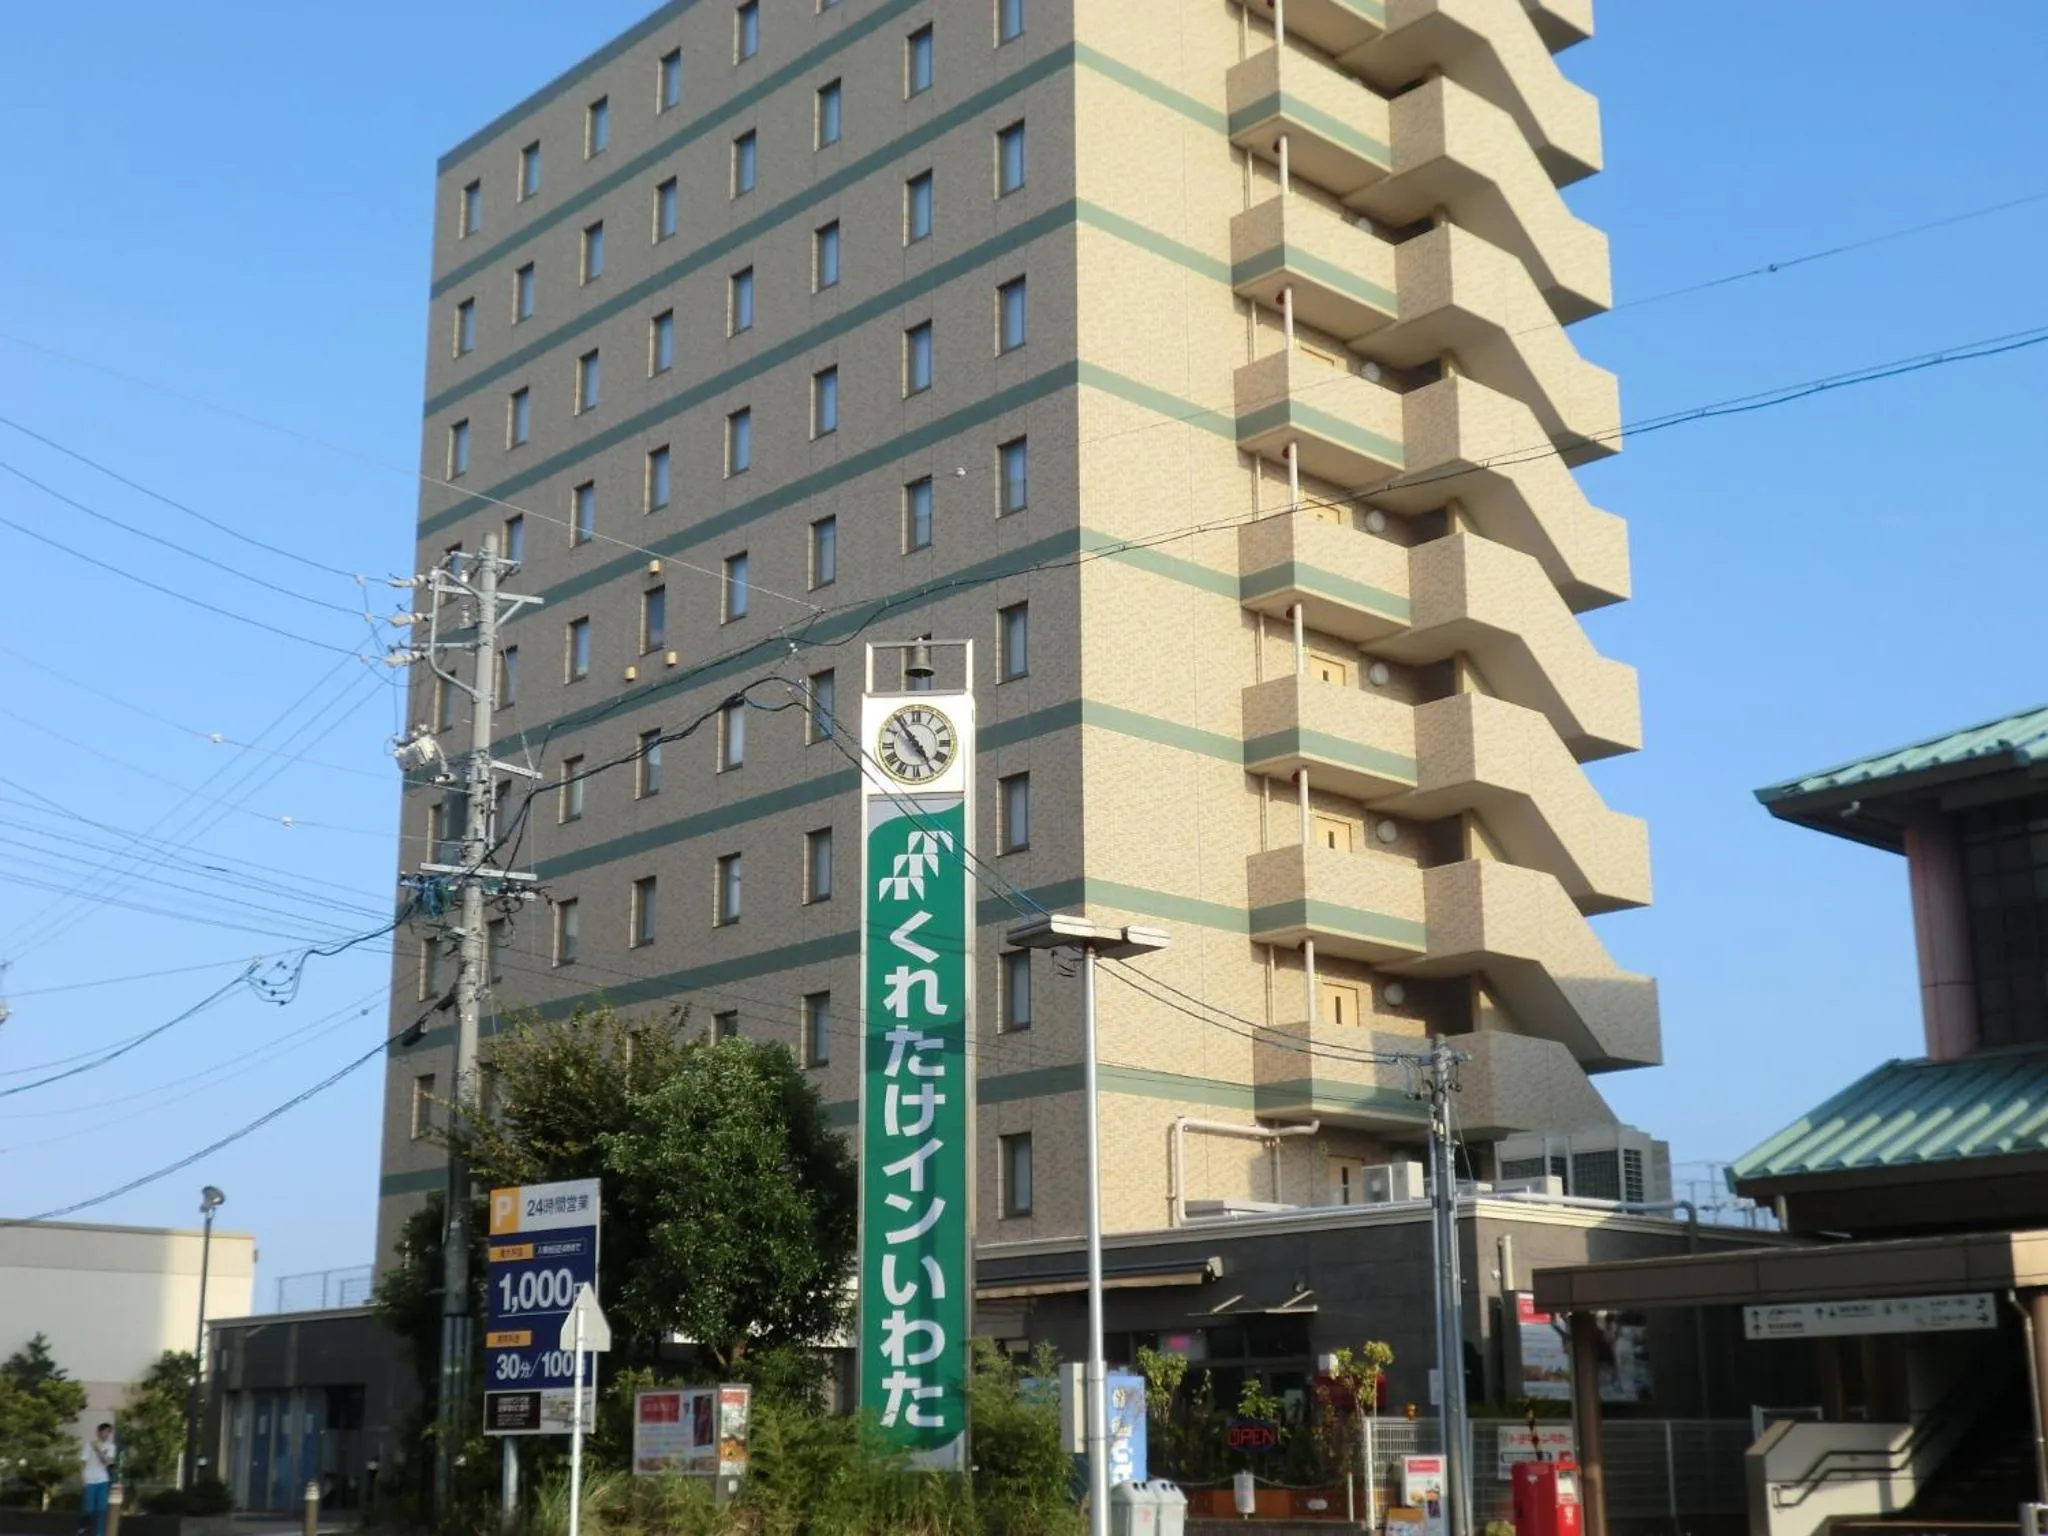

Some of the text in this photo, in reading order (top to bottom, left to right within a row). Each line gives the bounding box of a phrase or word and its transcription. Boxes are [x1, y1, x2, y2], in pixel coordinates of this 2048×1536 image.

[880, 910, 948, 1428] くれたけインいわた
[527, 1194, 589, 1217] 24時間営業
[496, 1351, 586, 1380] 30分/100
[1228, 1428, 1276, 1446] OPEN
